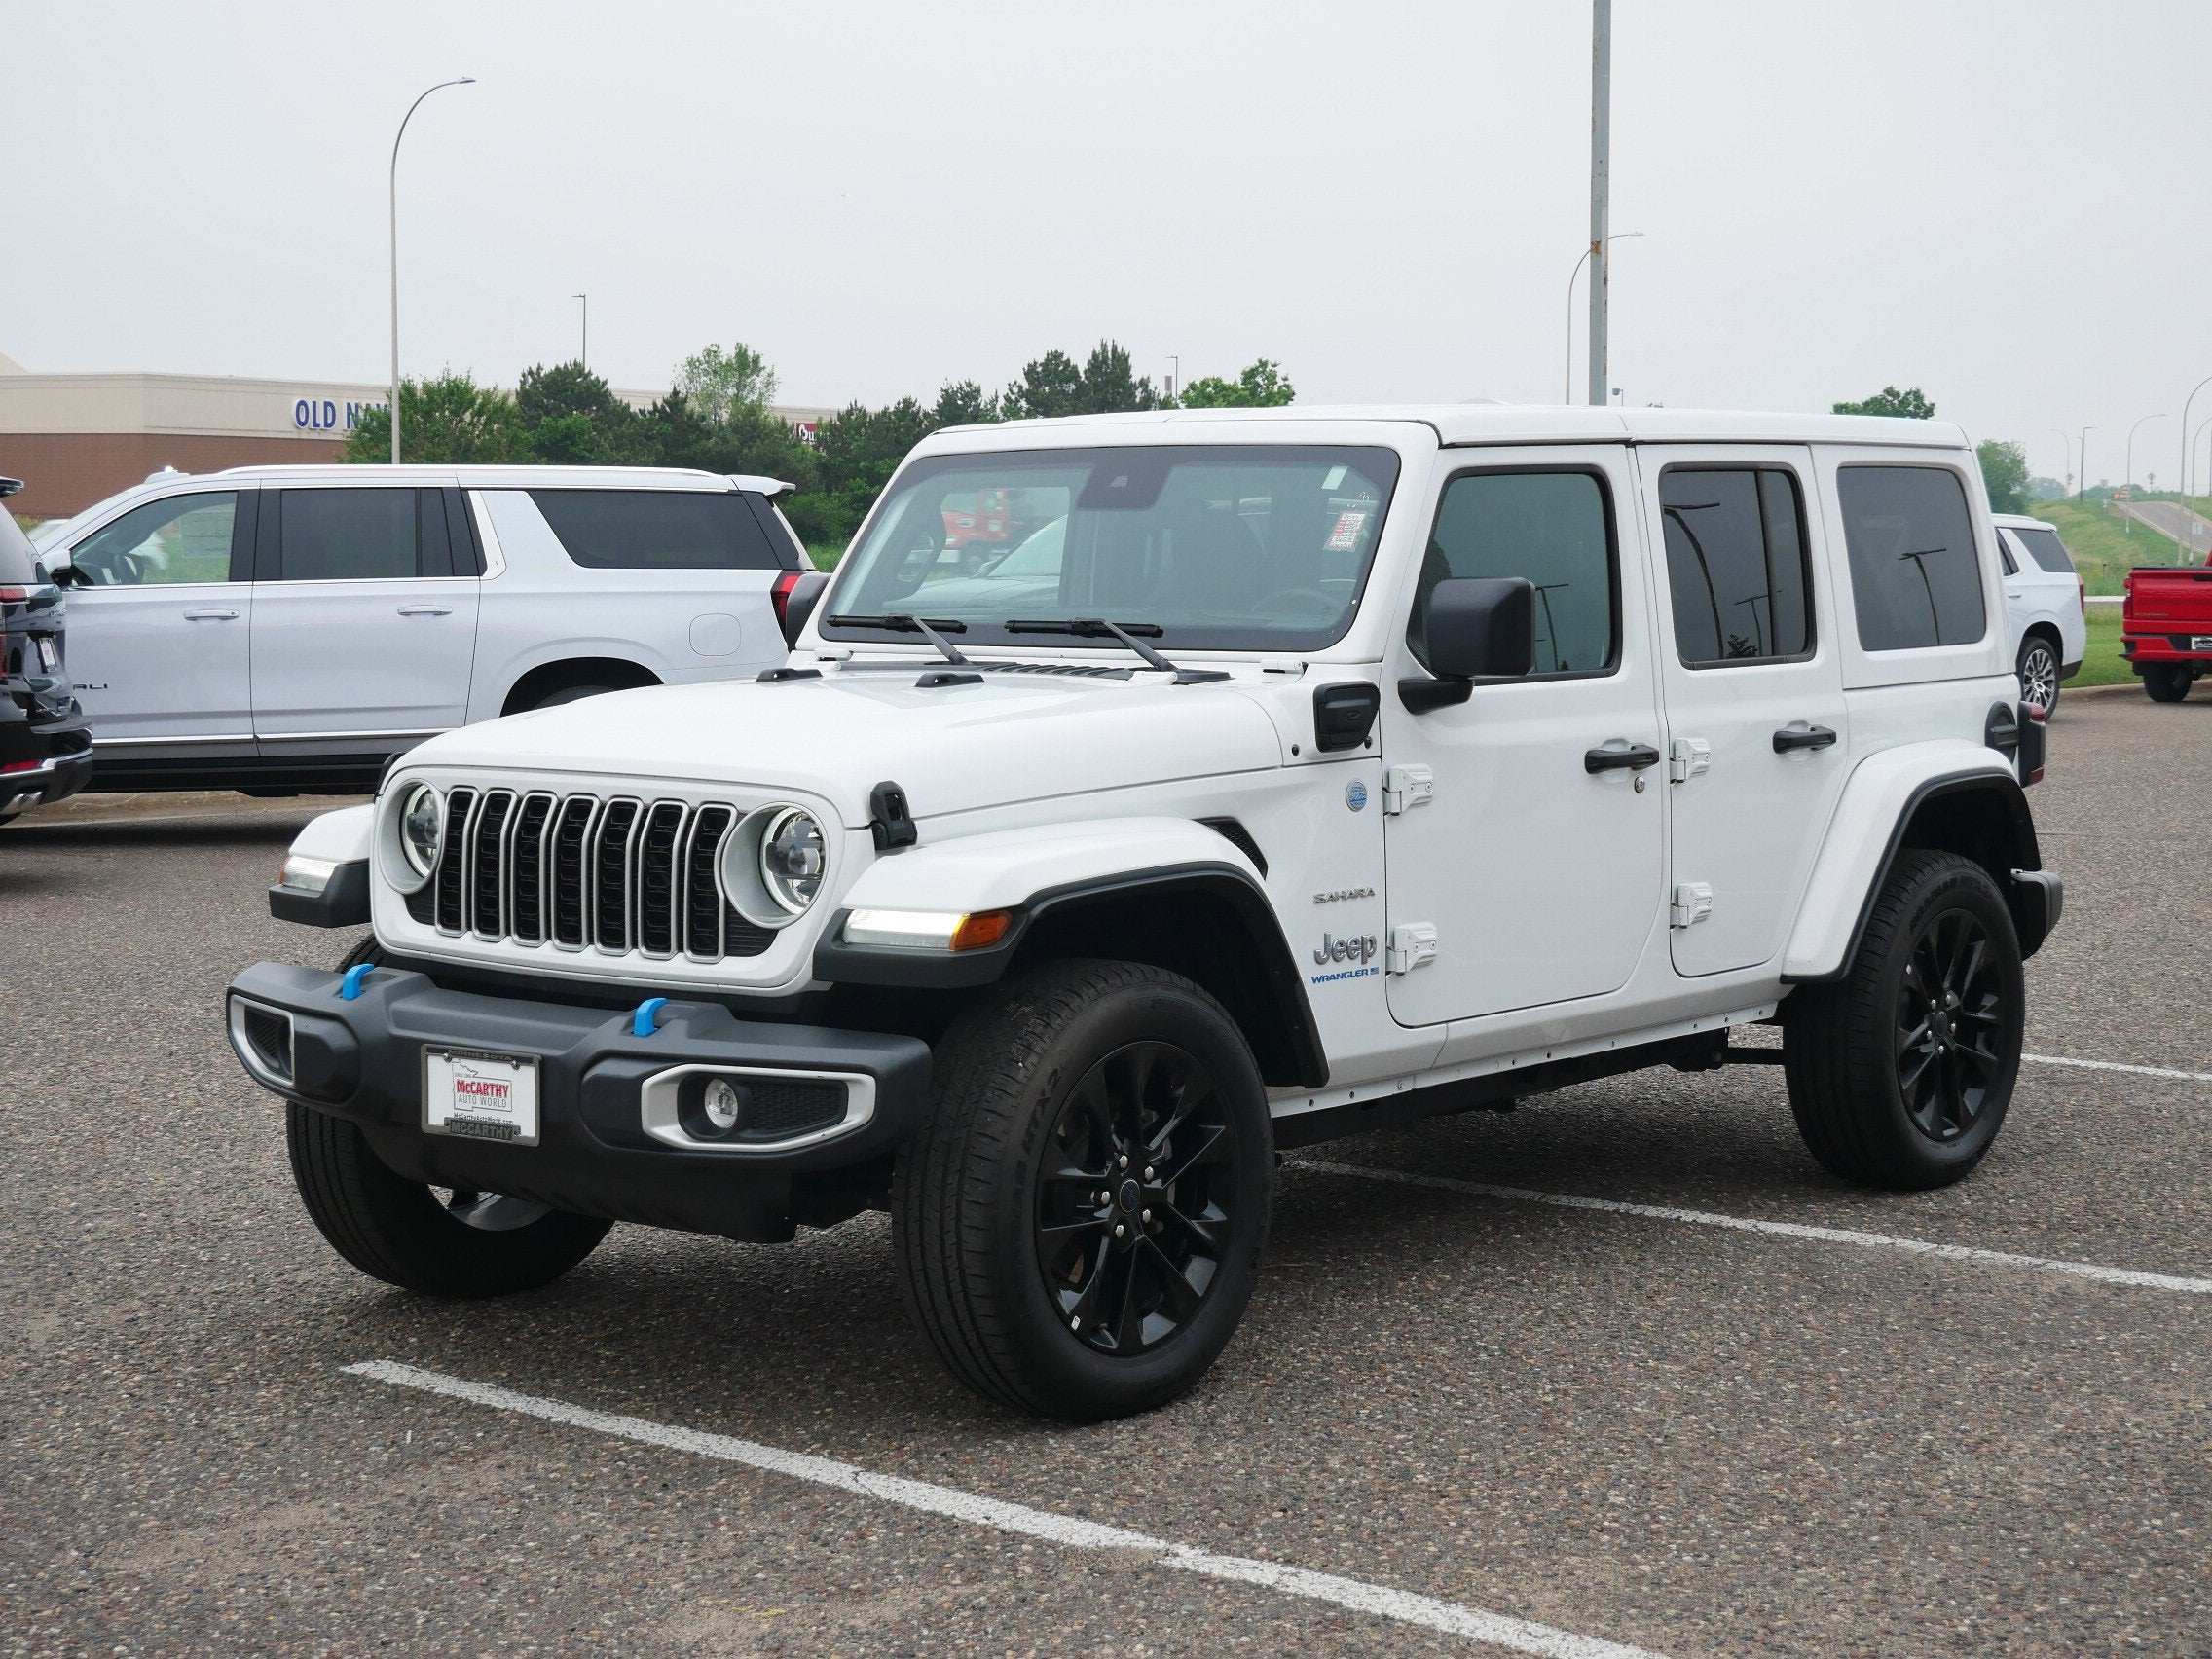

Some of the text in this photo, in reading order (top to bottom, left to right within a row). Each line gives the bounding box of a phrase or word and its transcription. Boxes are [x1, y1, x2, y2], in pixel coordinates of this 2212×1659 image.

[294, 398, 337, 428] OLD
[1313, 887, 1376, 903] SAHARA
[1313, 931, 1377, 965] Jeep
[1311, 968, 1368, 984] WRANGLER
[456, 1080, 509, 1098] McCARTHY
[458, 1094, 506, 1108] AUTO WORLD
[451, 1122, 511, 1139] MCCARTHY
